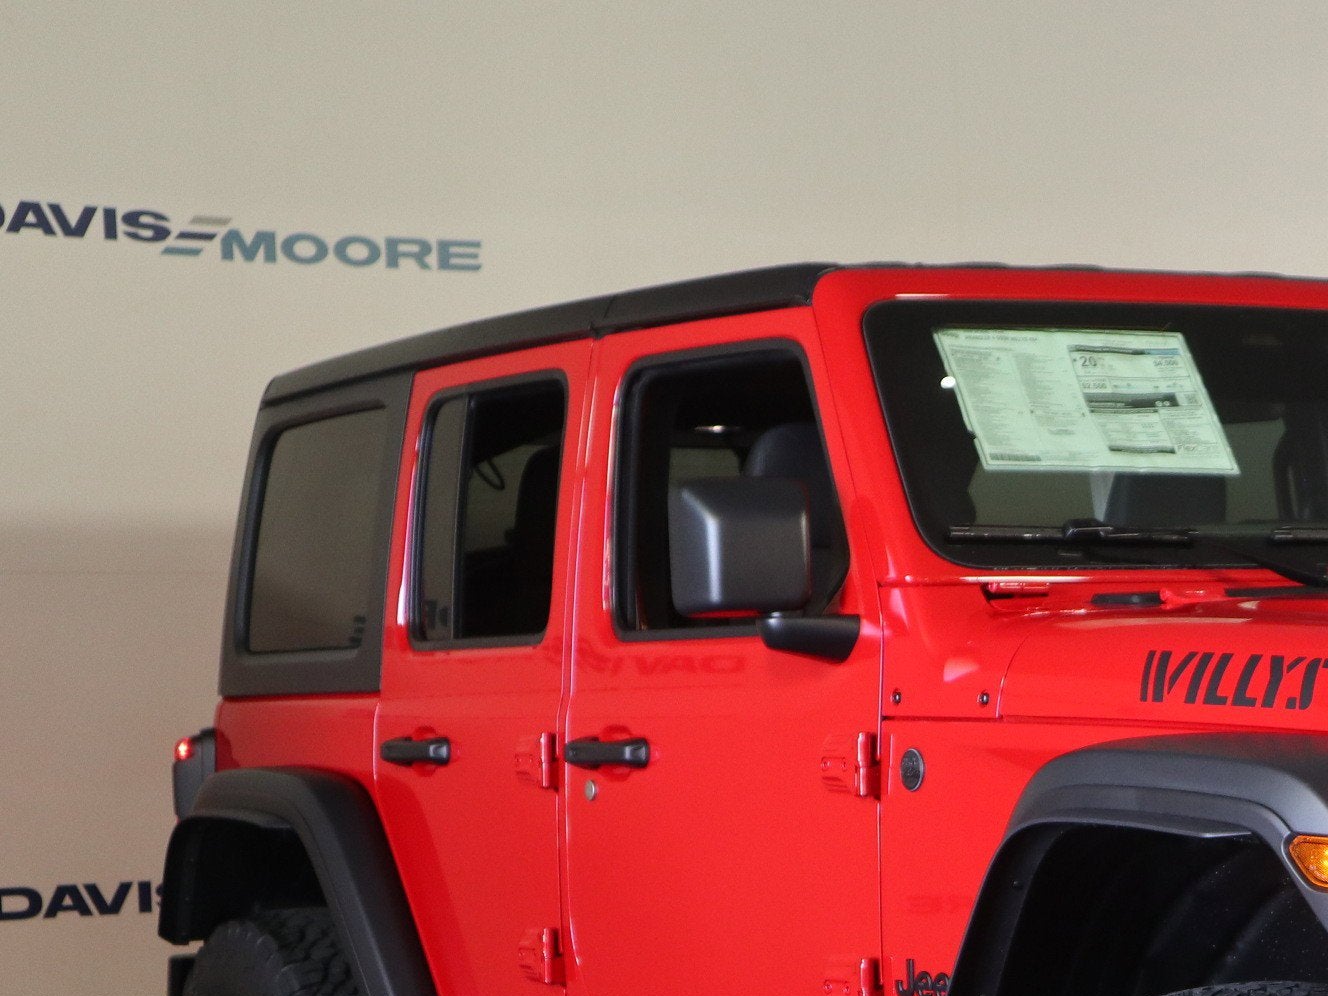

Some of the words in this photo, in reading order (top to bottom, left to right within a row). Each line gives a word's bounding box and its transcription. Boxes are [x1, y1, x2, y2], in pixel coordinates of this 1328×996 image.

[0, 201, 172, 242] AVIS
[220, 229, 482, 271] MOORE
[0, 881, 164, 921] DAVI
